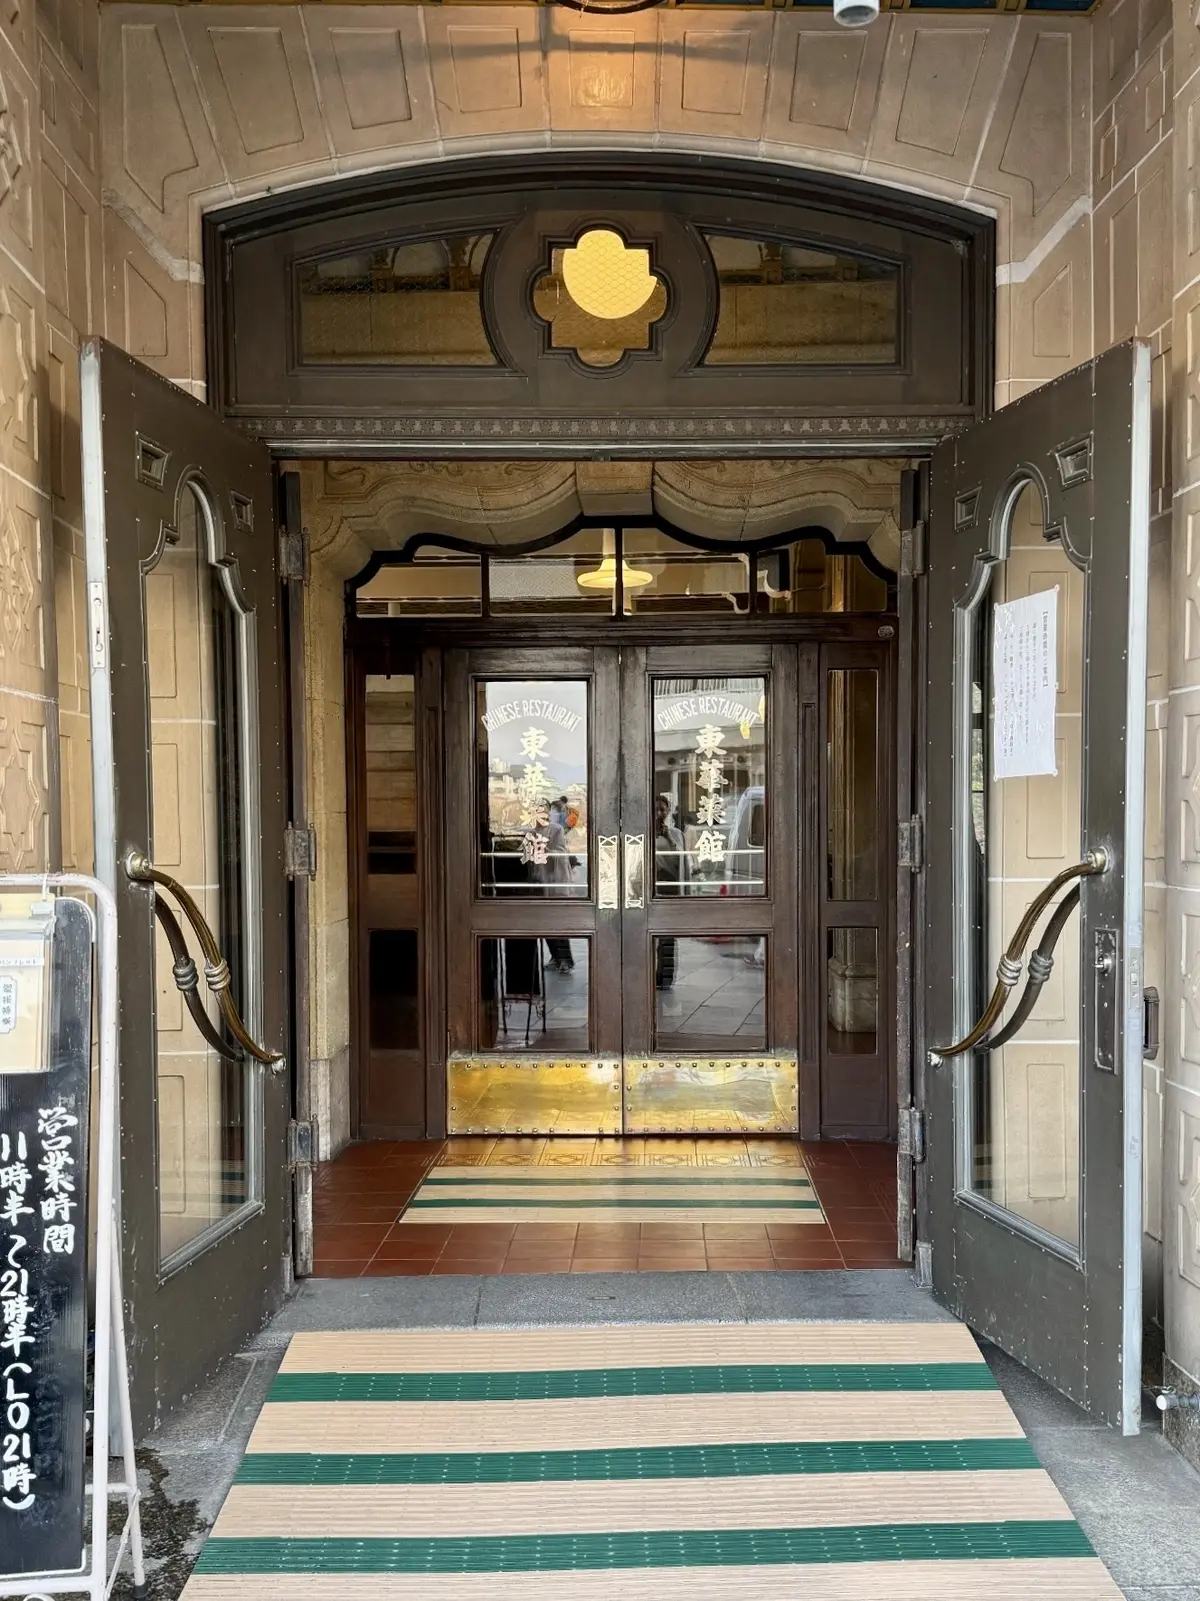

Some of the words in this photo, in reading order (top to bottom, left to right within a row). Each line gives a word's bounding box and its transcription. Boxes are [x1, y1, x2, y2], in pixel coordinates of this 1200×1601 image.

[481, 700, 522, 732] CHINESE
[522, 698, 583, 733] RESTAURANT
[657, 698, 699, 730] CHINESE
[698, 696, 761, 727] RESTAURANT
[695, 723, 728, 863] 東華菜館
[38, 1106, 78, 1255] 営業時間
